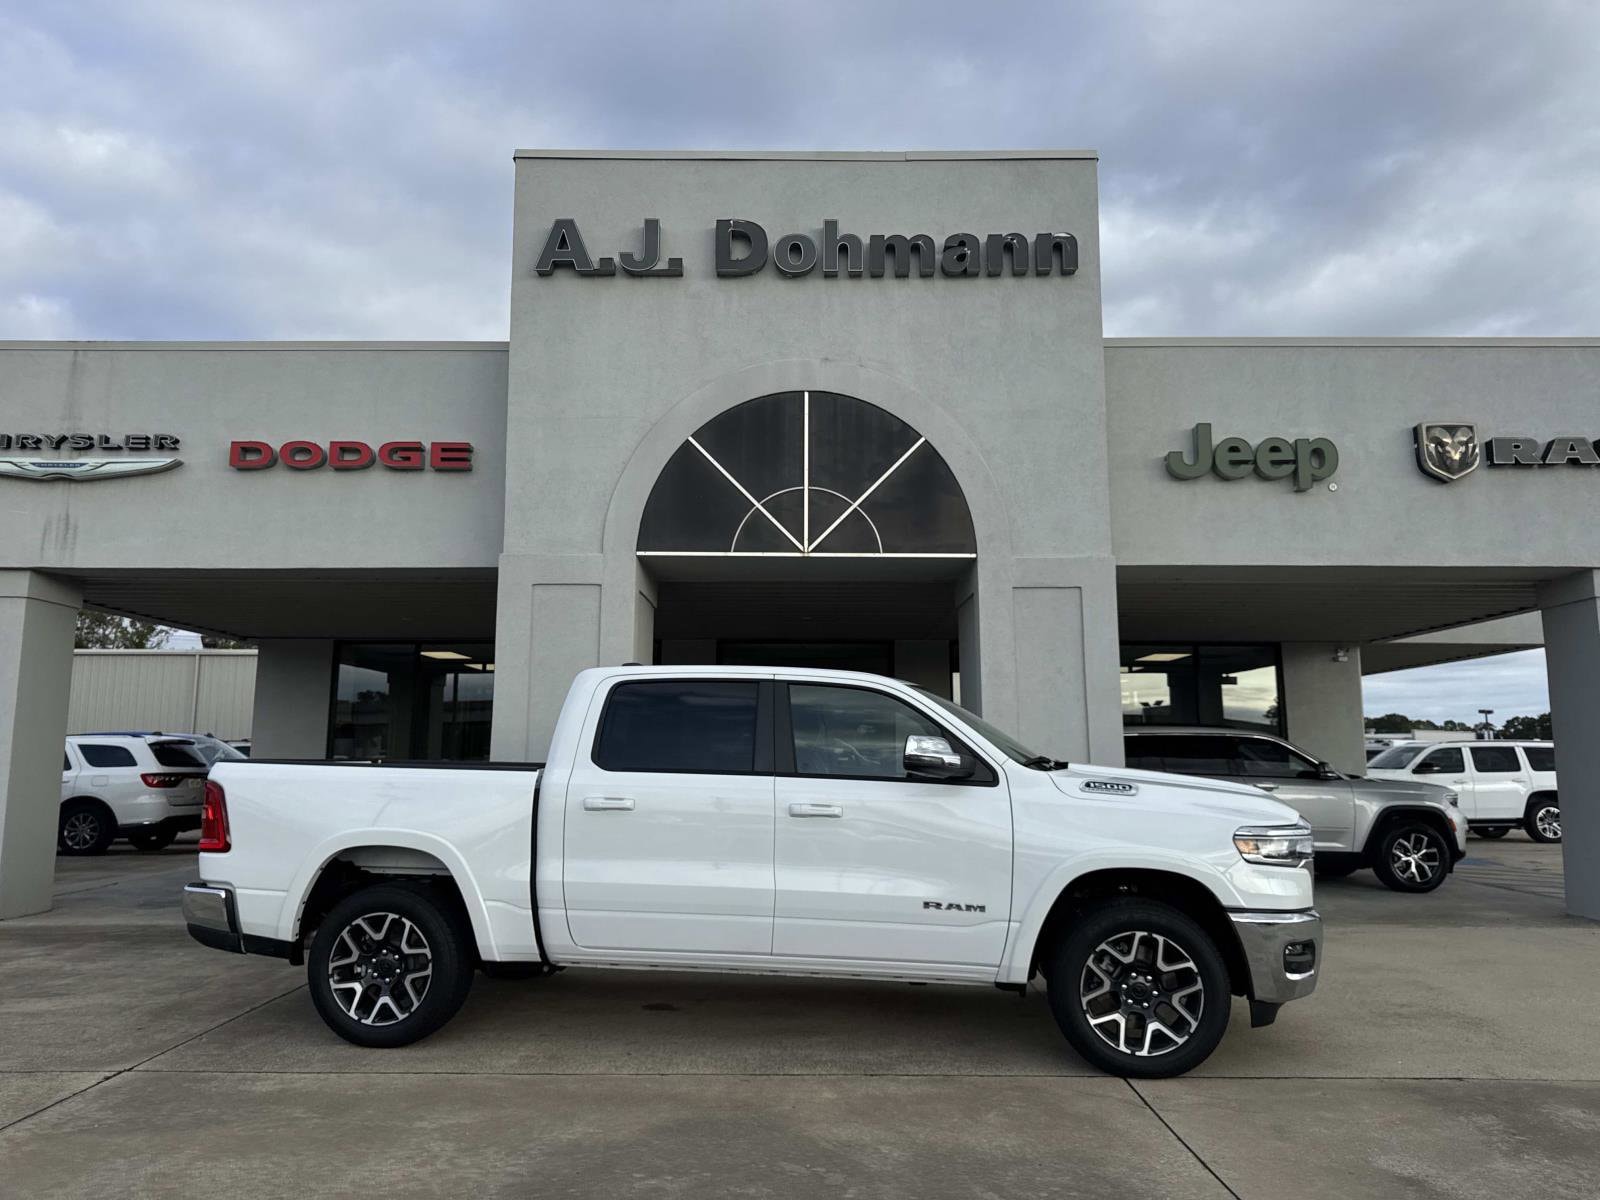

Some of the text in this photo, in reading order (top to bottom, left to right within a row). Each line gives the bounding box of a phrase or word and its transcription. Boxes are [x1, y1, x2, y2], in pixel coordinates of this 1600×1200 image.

[535, 218, 1079, 278] A.J. Dohmann
[229, 440, 473, 471] DODGE
[1166, 422, 1338, 492] Jeep
[1485, 436, 1600, 466] RA
[1089, 782, 1130, 791] 1500
[923, 901, 986, 913] RAM
